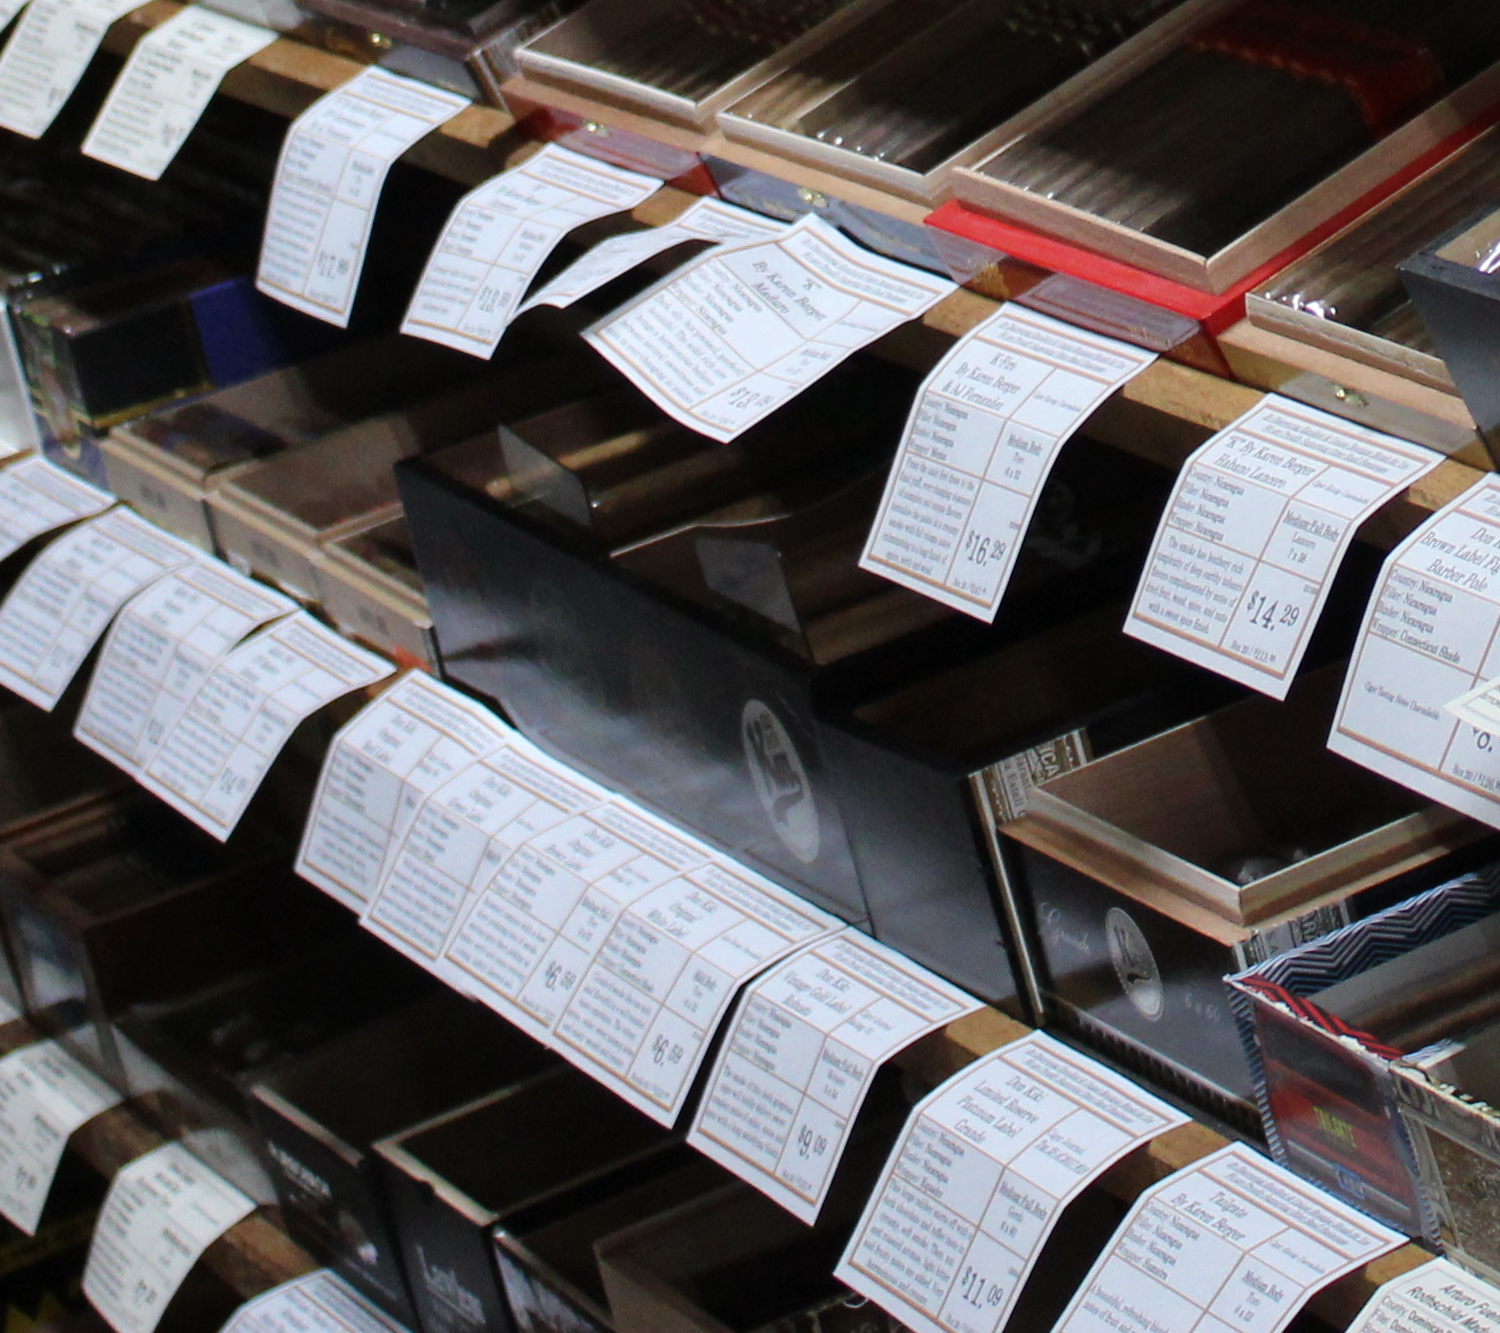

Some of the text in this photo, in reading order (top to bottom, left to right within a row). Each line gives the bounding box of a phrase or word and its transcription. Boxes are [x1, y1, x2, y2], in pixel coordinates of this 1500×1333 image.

[1280, 456, 1316, 476] Berger
[964, 529, 1006, 566] $16.29
[1419, 530, 1456, 555] Brown
[1452, 543, 1490, 566] Label
[1469, 525, 1495, 545] Don
[1425, 557, 1488, 593] Barber Pole
[1246, 590, 1300, 631] $14.29
[960, 1265, 1003, 1309] $11.09
